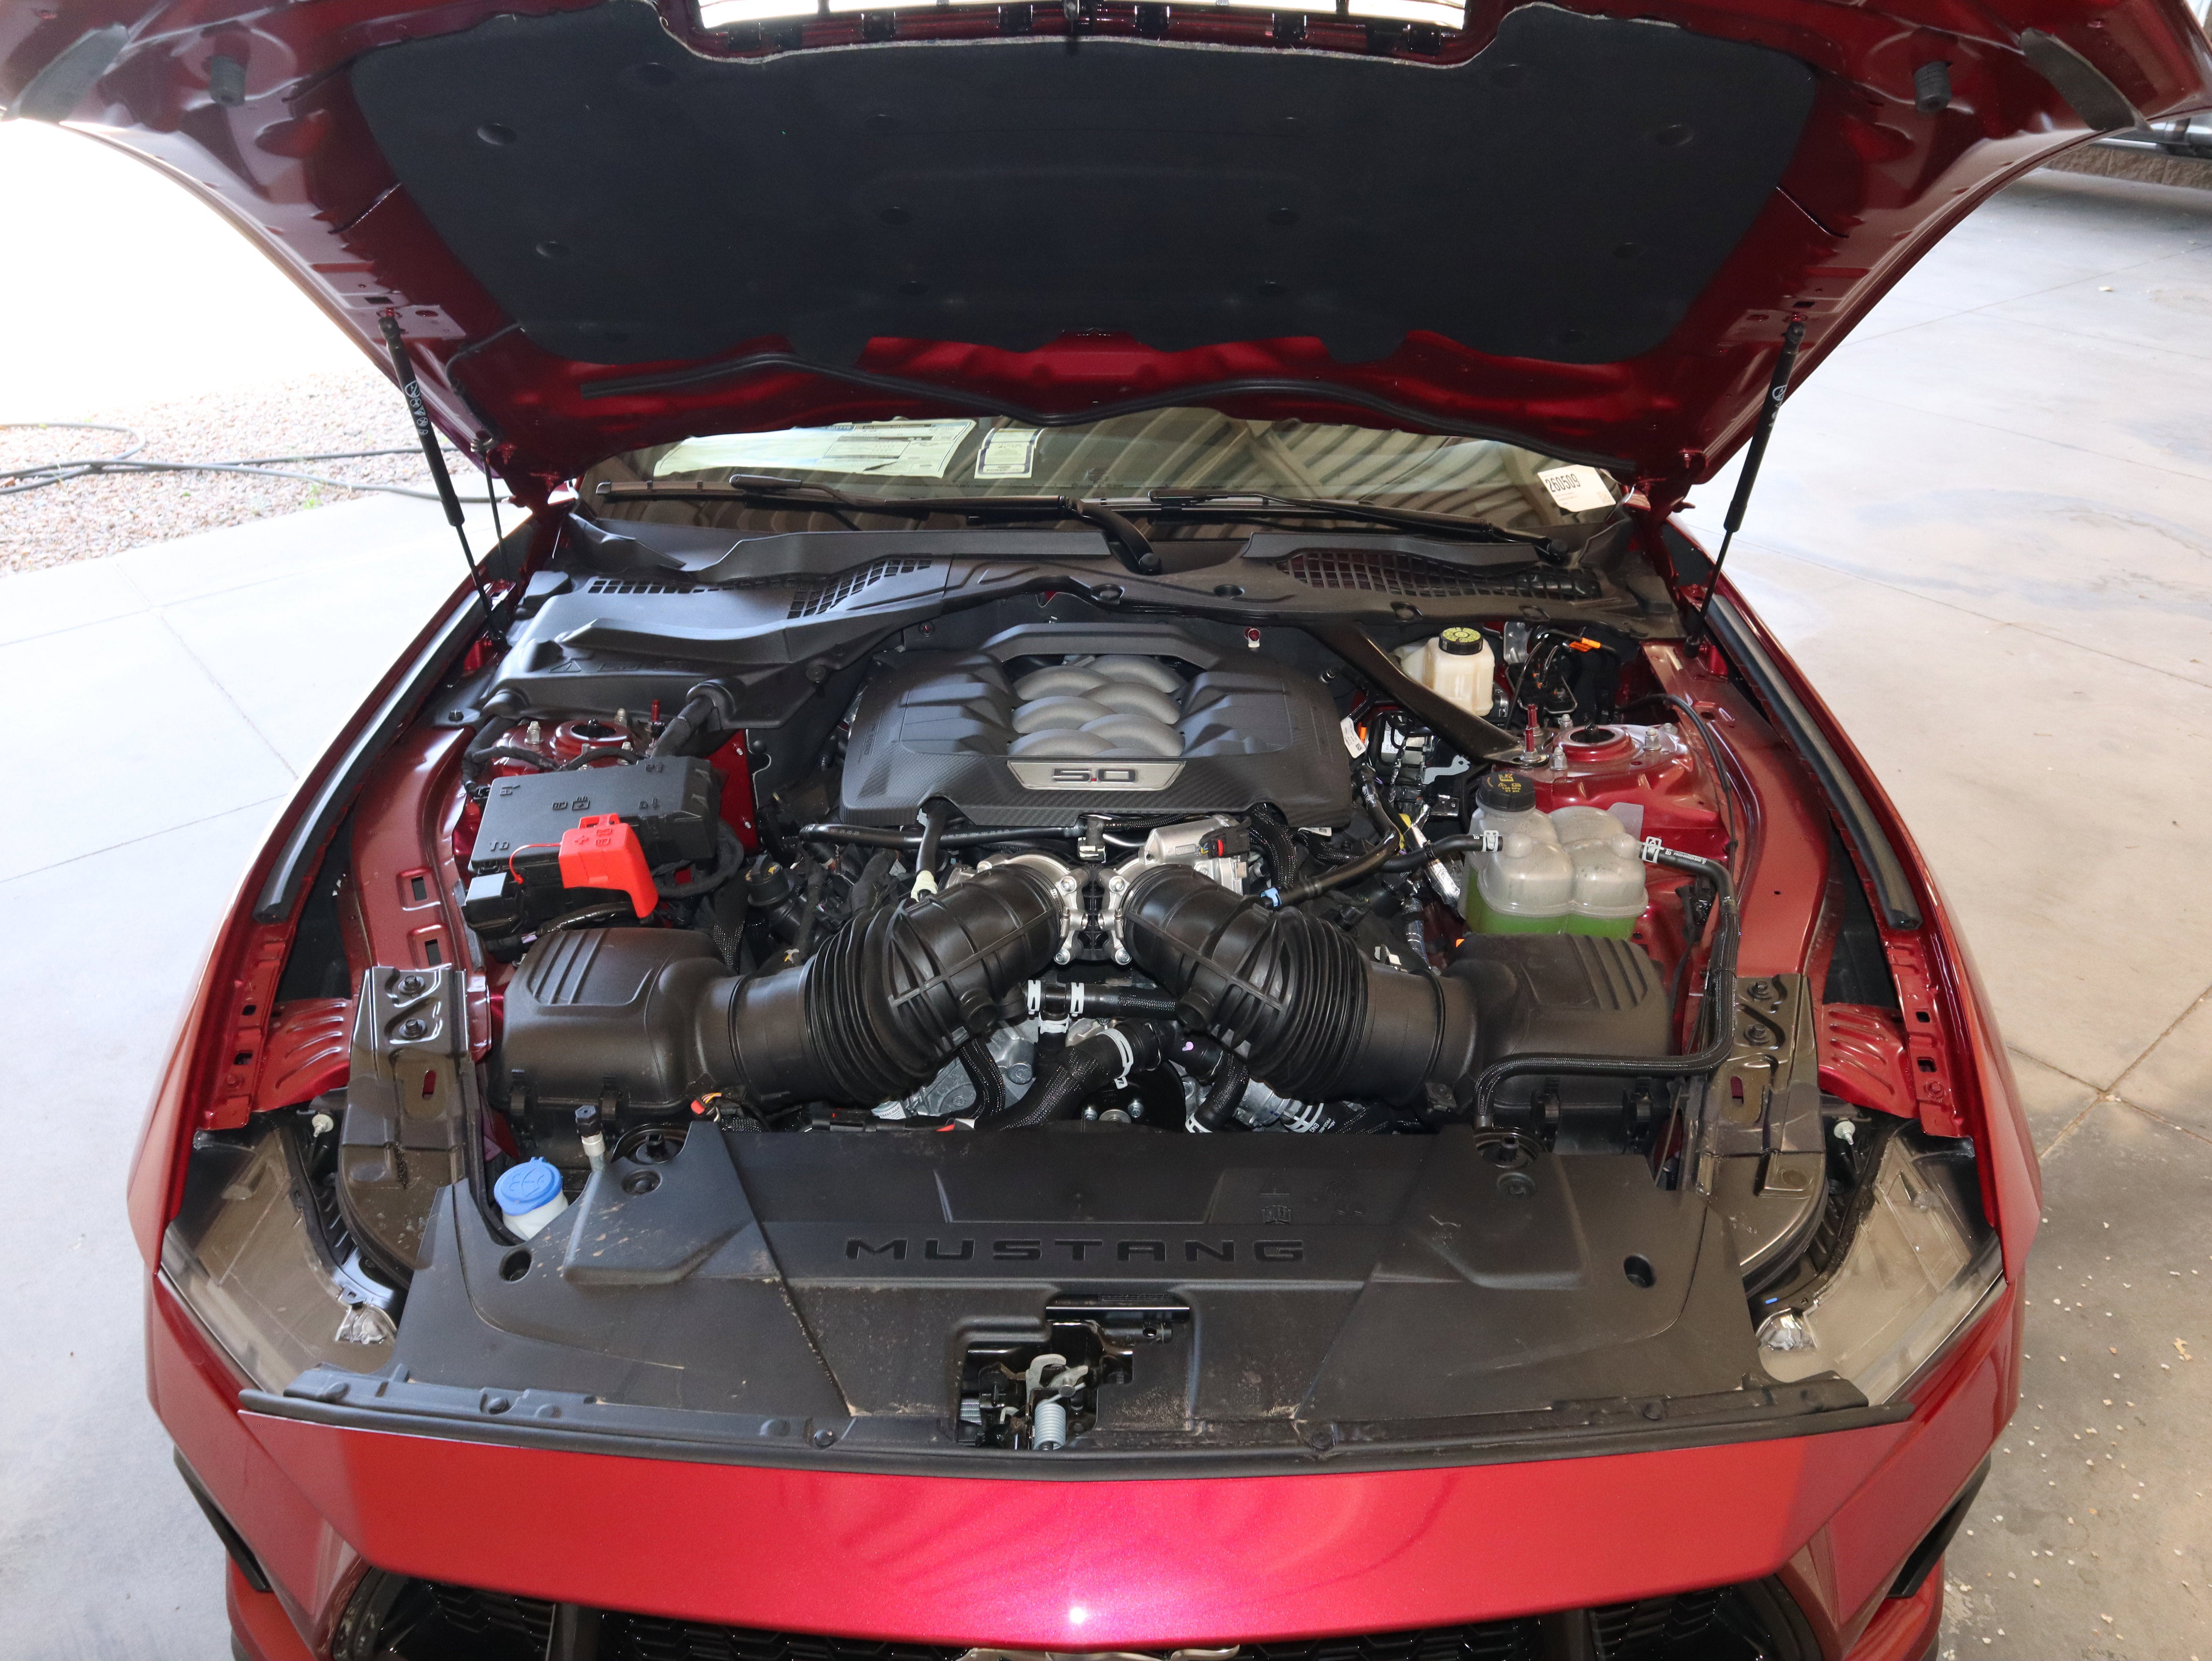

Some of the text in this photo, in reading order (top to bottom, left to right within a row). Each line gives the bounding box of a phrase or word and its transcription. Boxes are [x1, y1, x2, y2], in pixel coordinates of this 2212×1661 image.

[1545, 473, 1581, 492] 260509
[1053, 768, 1138, 783] 5.0
[1309, 1122, 1320, 1133] ENG
[846, 1238, 1305, 1261] MUSTANG
